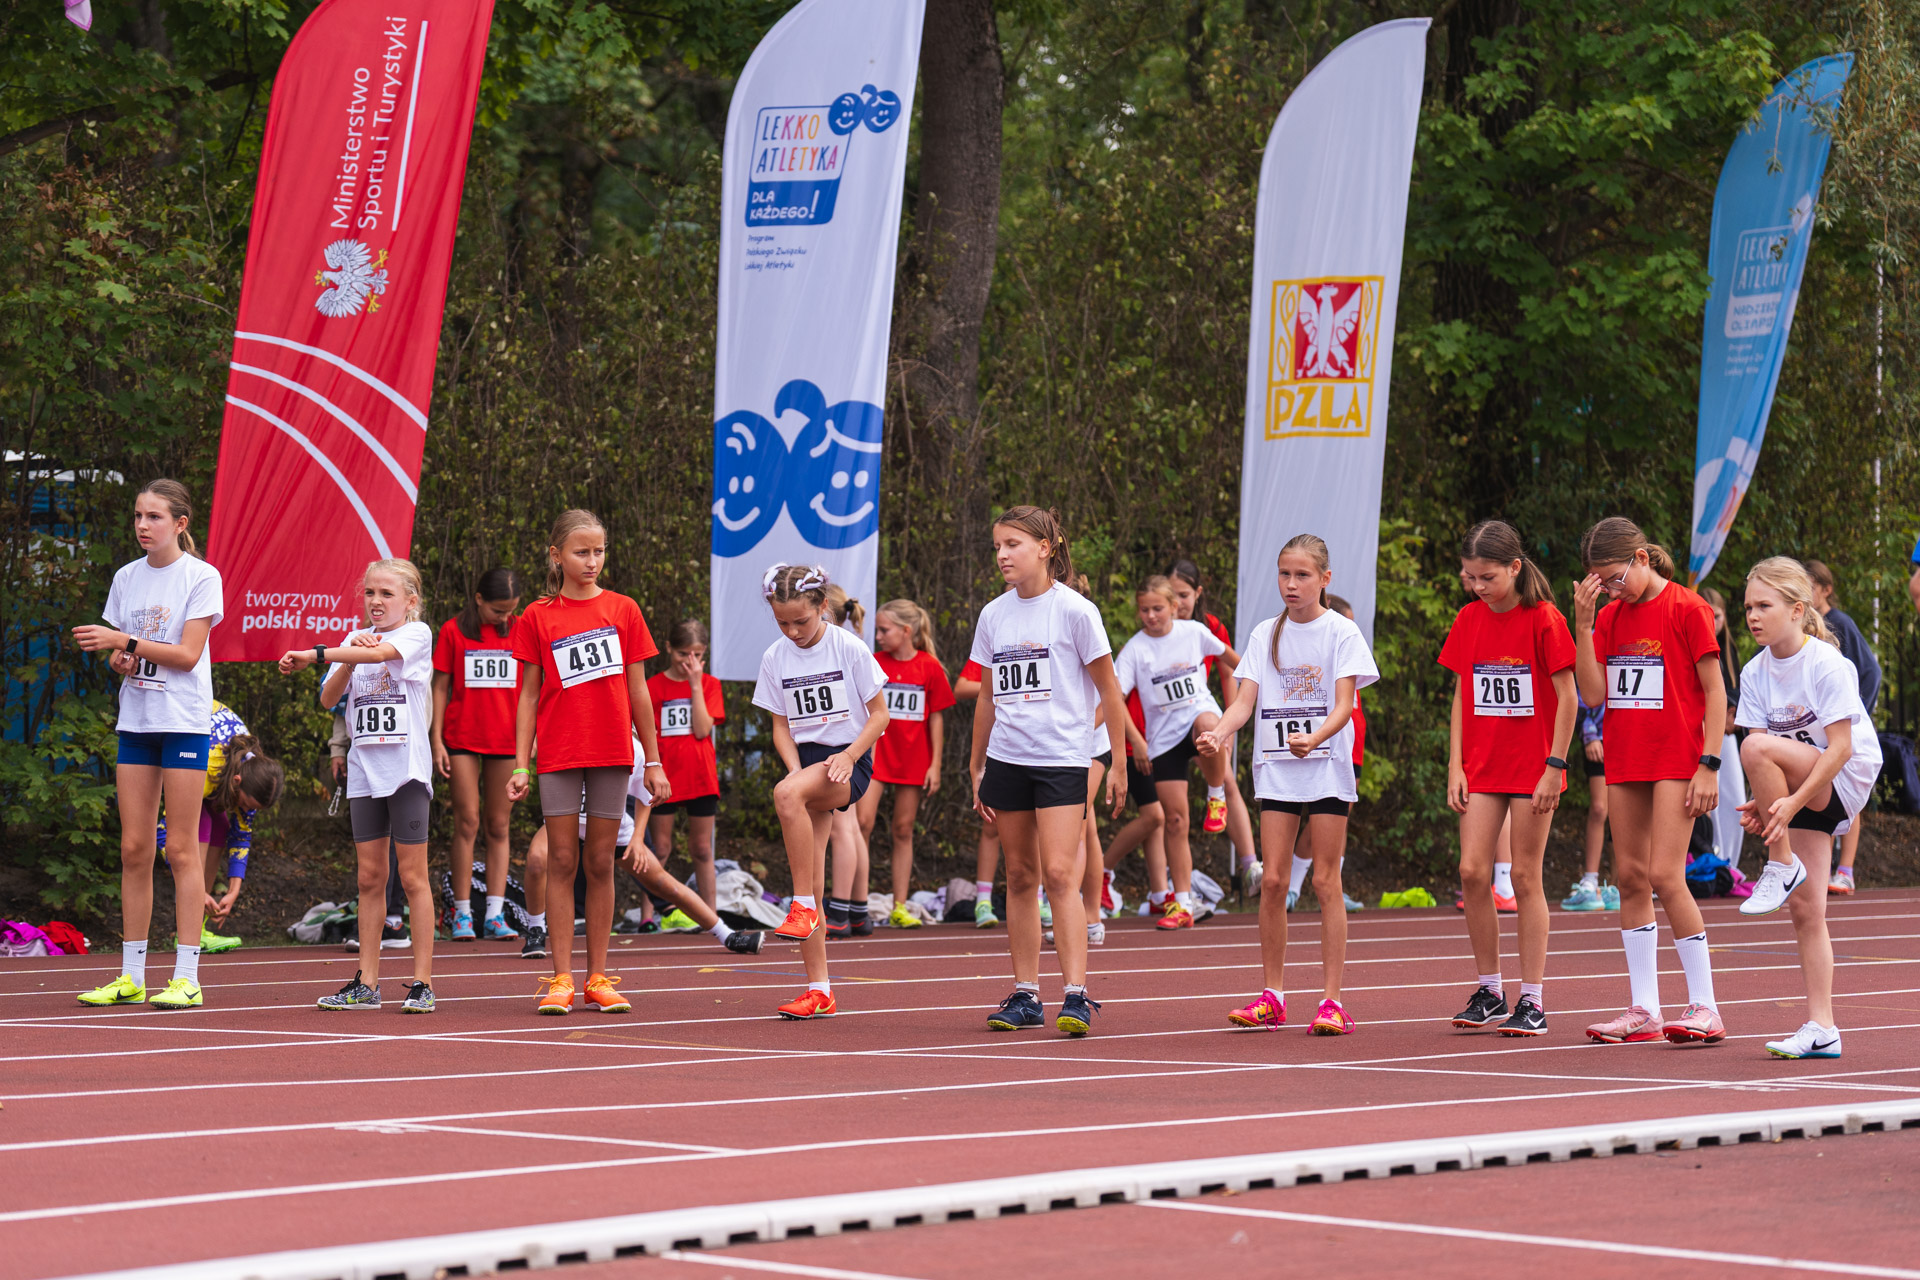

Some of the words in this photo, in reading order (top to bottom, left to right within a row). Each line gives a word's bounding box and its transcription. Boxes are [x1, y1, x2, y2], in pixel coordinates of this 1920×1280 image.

[357, 149, 387, 230] Sportu
[373, 16, 407, 128] Turystyki
[762, 114, 820, 140] LEKKO
[331, 67, 370, 228] Ministerstwo
[756, 145, 839, 173] ATLETYKA
[752, 190, 775, 203] DLA
[1273, 384, 1363, 430] PZLA
[245, 590, 341, 612] tworzymy
[242, 610, 302, 633] polski
[305, 615, 360, 634] sport
[569, 639, 613, 671] 431
[474, 659, 508, 678] 560
[999, 662, 1040, 691] 304
[1164, 677, 1195, 701] 106
[1481, 677, 1521, 704] 266
[1617, 669, 1644, 696] 47
[794, 685, 834, 715] 159
[887, 691, 918, 711] 140
[356, 707, 396, 733] 493
[668, 708, 692, 726] 53
[179, 751, 198, 759] PUMA
